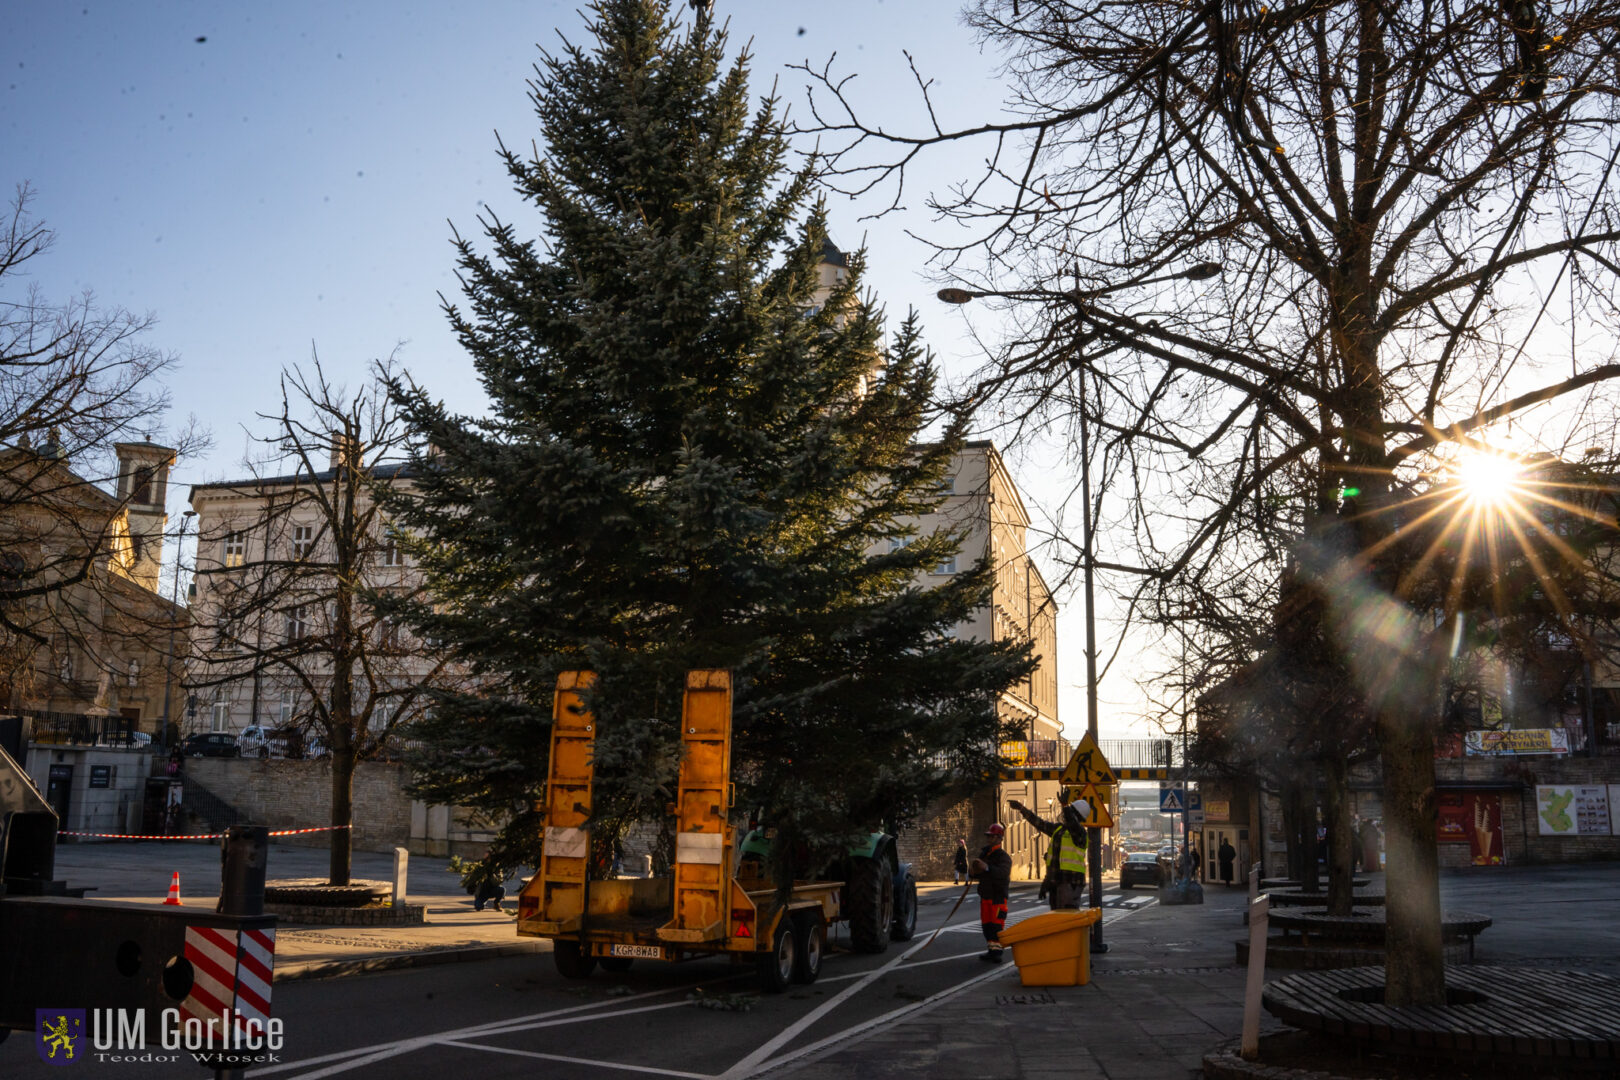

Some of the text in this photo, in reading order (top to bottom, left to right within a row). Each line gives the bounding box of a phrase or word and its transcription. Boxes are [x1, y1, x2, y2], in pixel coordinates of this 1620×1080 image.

[1189, 795, 1198, 809] P
[616, 945, 658, 957] KGR 8WA8
